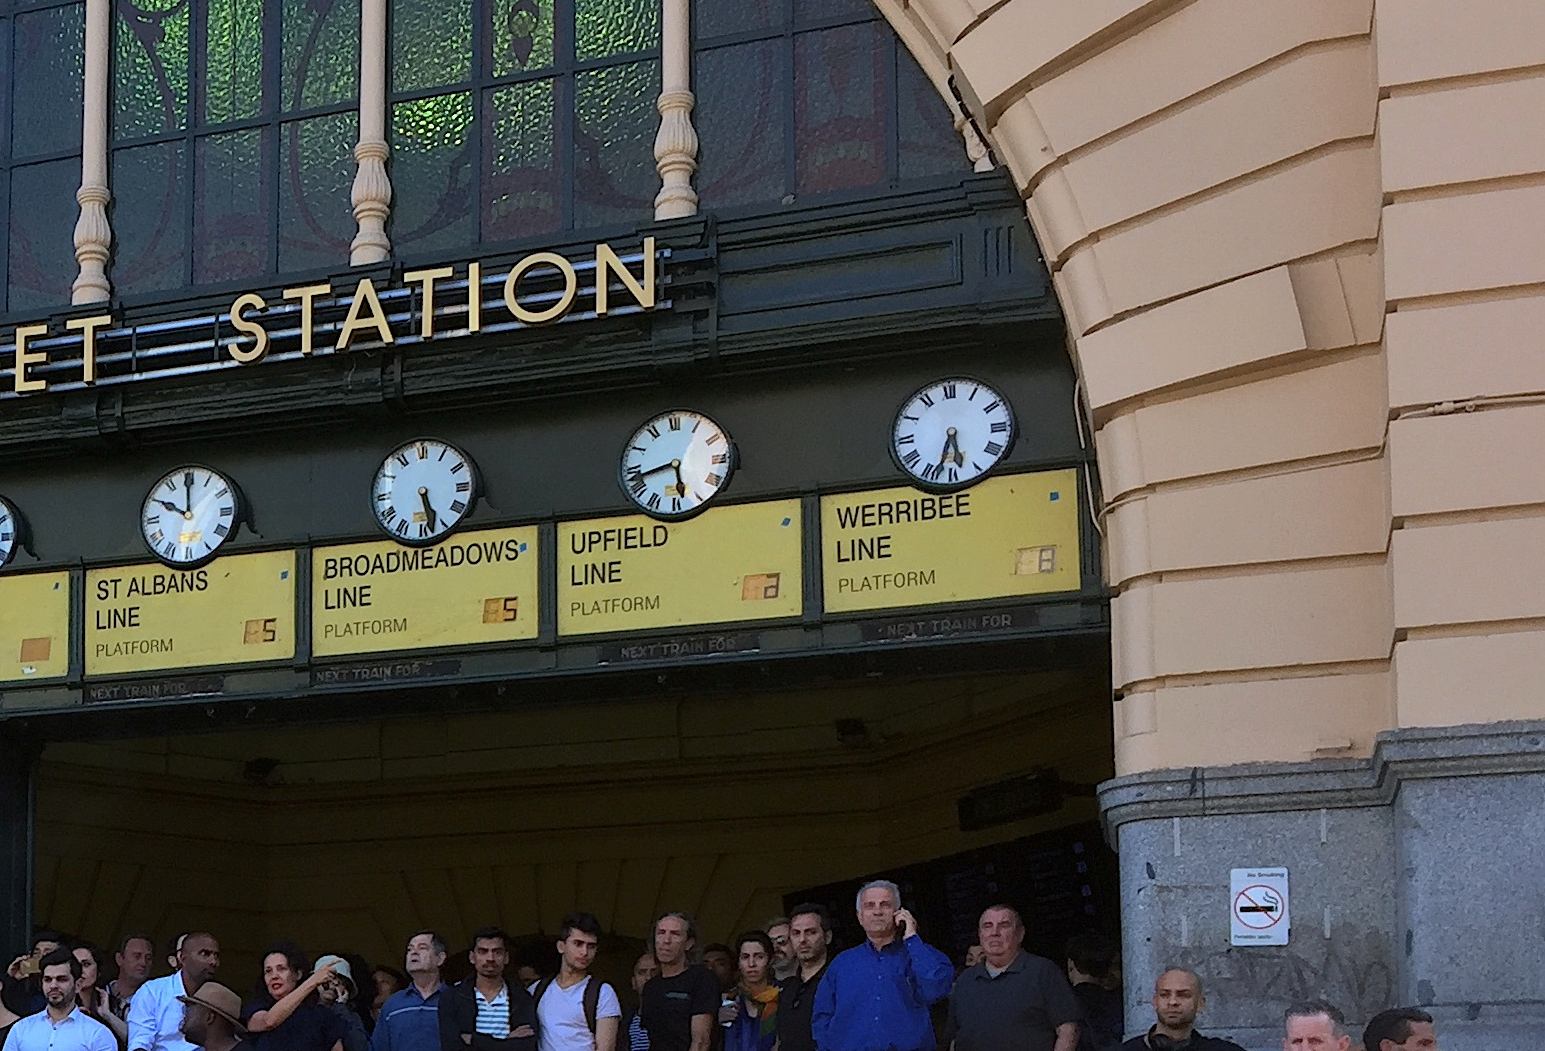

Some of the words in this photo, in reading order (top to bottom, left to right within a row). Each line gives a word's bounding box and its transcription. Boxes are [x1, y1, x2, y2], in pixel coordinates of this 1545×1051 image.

[227, 236, 656, 363] STATION
[837, 494, 971, 529] WERRIBEE
[571, 525, 668, 554] UPFIELD
[837, 536, 892, 563] LINE
[324, 539, 519, 579] BROADMEADOWS
[97, 578, 122, 600] ST
[127, 570, 209, 598] ALBANS
[571, 561, 622, 586] LINE
[838, 570, 936, 593] PLATFORM
[324, 585, 372, 610] LINE
[571, 595, 660, 617] PLATFORM
[96, 607, 140, 630] LINE
[324, 618, 407, 639] PLATFORM
[932, 619, 977, 633] TRAIN
[982, 614, 1012, 627] FOR
[96, 638, 173, 658] PLATFORM
[621, 645, 656, 658] NEXT
[661, 642, 703, 655] TRAIN
[708, 637, 737, 650] FOR
[316, 669, 348, 683] NEXT
[352, 667, 392, 680] TRAIN
[396, 663, 421, 676] FOR
[89, 687, 119, 699] NEXT
[124, 685, 159, 697] TRAIN
[163, 683, 188, 694] FOR
